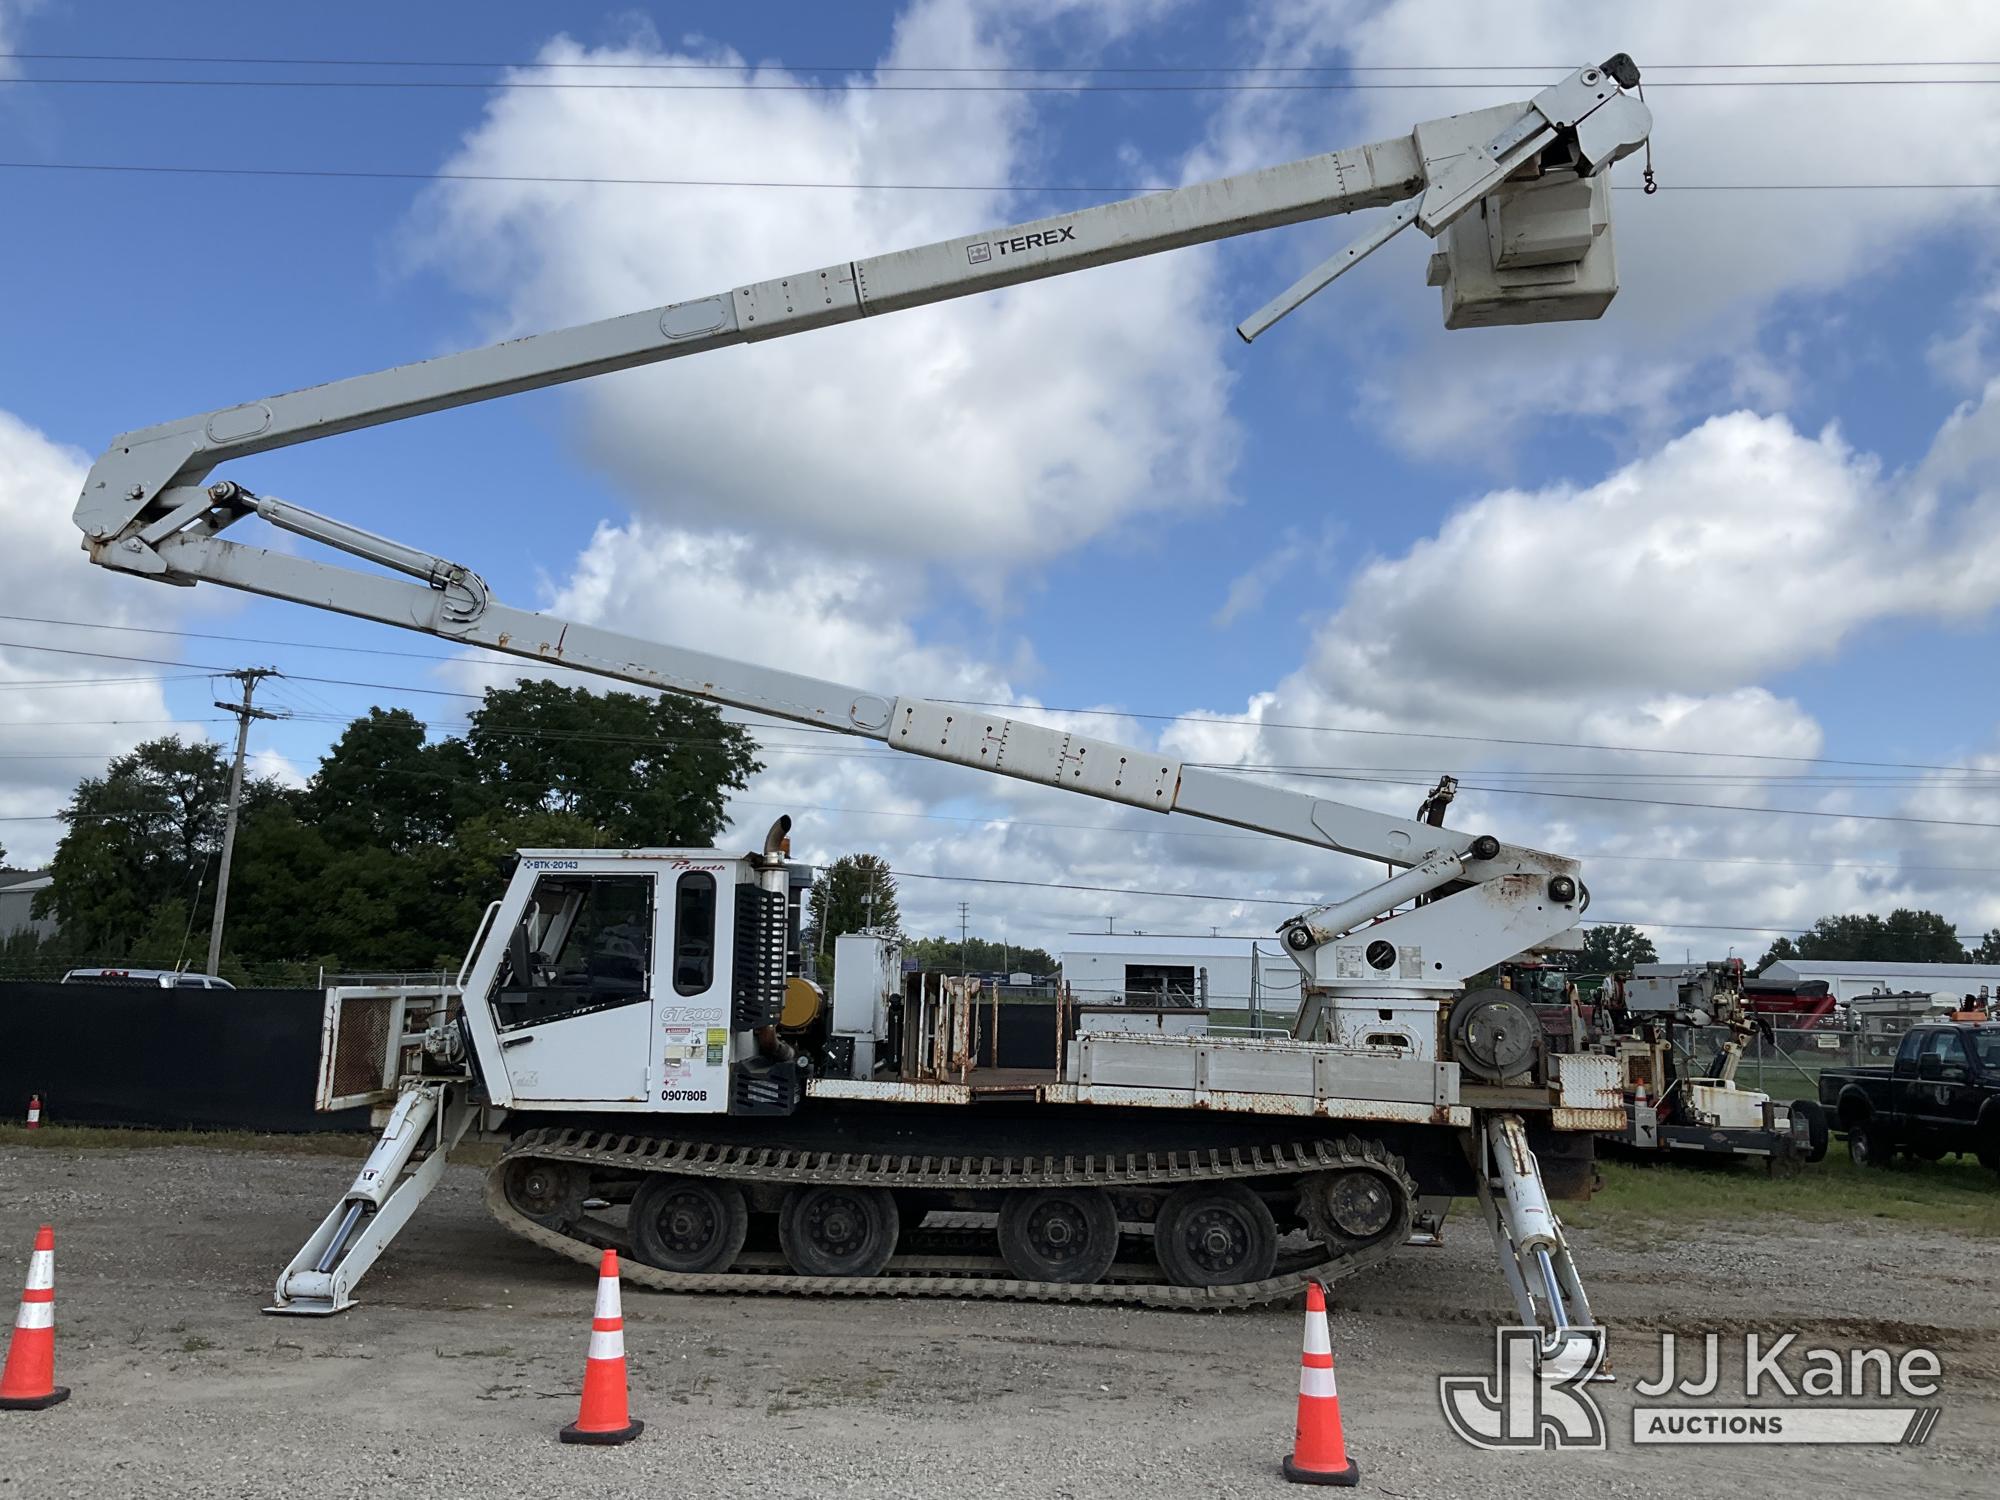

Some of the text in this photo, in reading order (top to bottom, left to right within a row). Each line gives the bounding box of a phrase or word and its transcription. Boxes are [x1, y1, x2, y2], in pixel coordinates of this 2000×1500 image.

[994, 226, 1077, 255] TEREX
[533, 861, 578, 869] BTK-20143
[661, 1090, 707, 1101] 090780B
